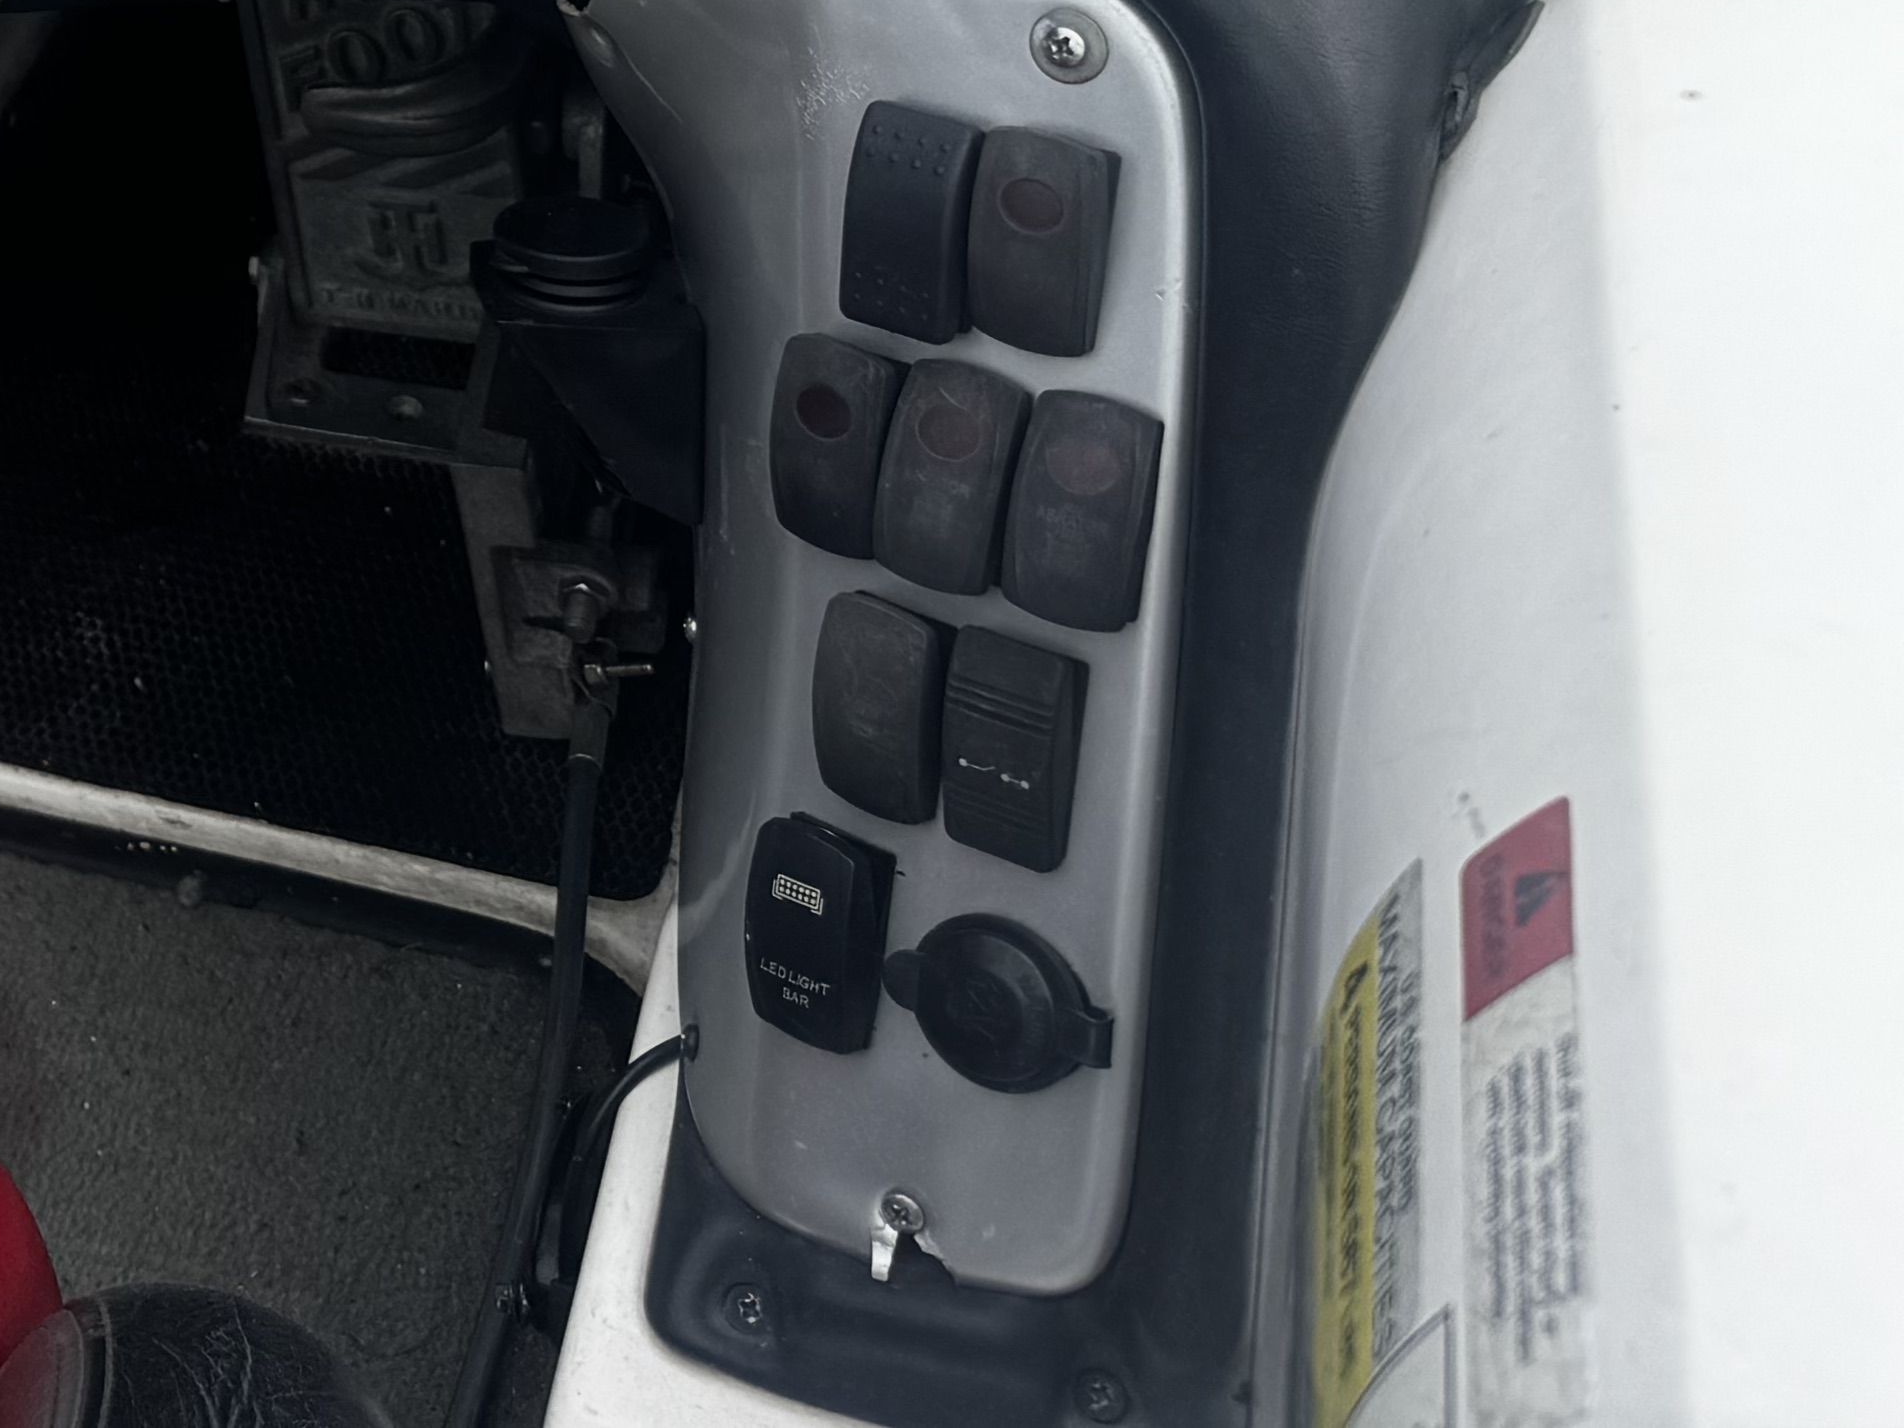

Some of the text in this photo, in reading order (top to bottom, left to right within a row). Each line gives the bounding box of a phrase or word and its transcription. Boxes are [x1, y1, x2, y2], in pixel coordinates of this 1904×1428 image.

[759, 957, 831, 996] LED LIGHT
[782, 987, 810, 1008] BAR
